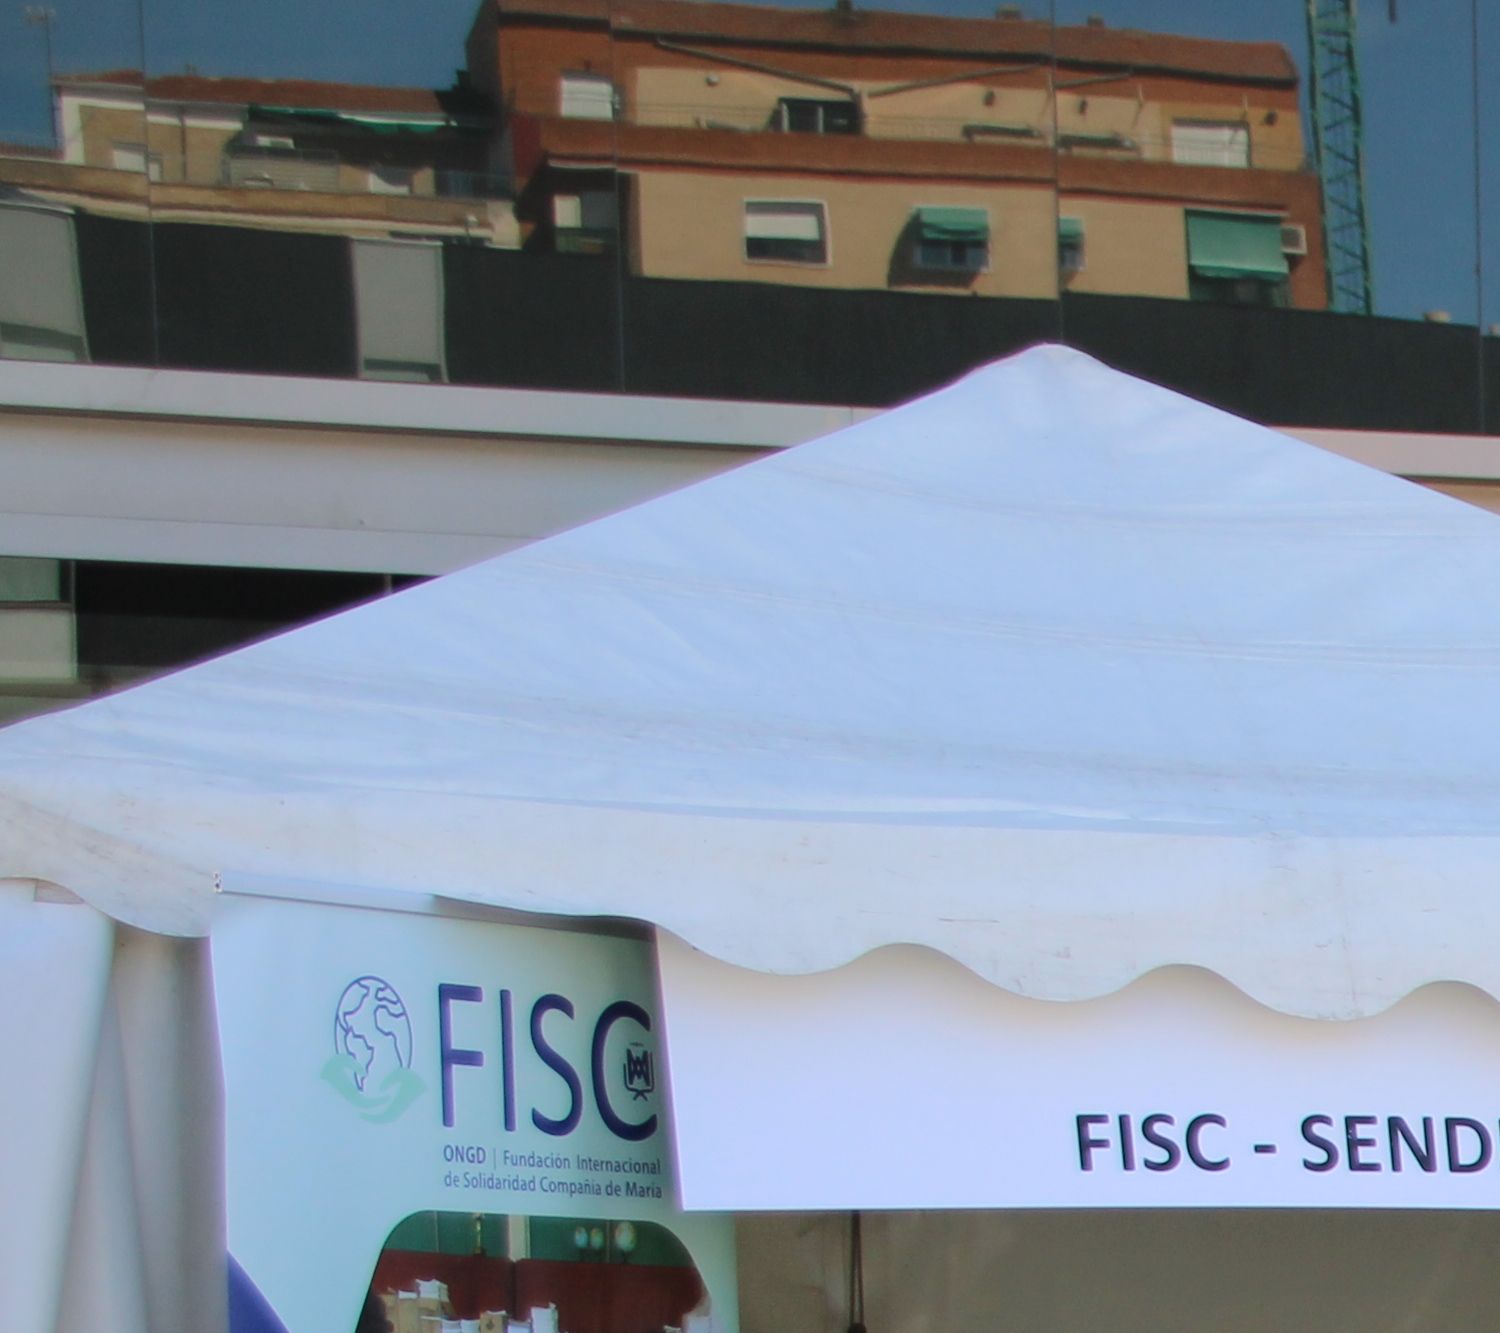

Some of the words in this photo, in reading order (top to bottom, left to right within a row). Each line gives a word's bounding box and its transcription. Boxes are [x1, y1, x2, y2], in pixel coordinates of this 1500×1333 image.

[439, 983, 657, 1141] FISC
[443, 1144, 486, 1164] ONGD
[503, 1150, 570, 1170] Fundación
[577, 1154, 661, 1175] Internacional
[1075, 1113, 1231, 1172] FISC
[444, 1171, 459, 1187] de
[463, 1172, 536, 1191] Solidaridad
[605, 1180, 620, 1196] de
